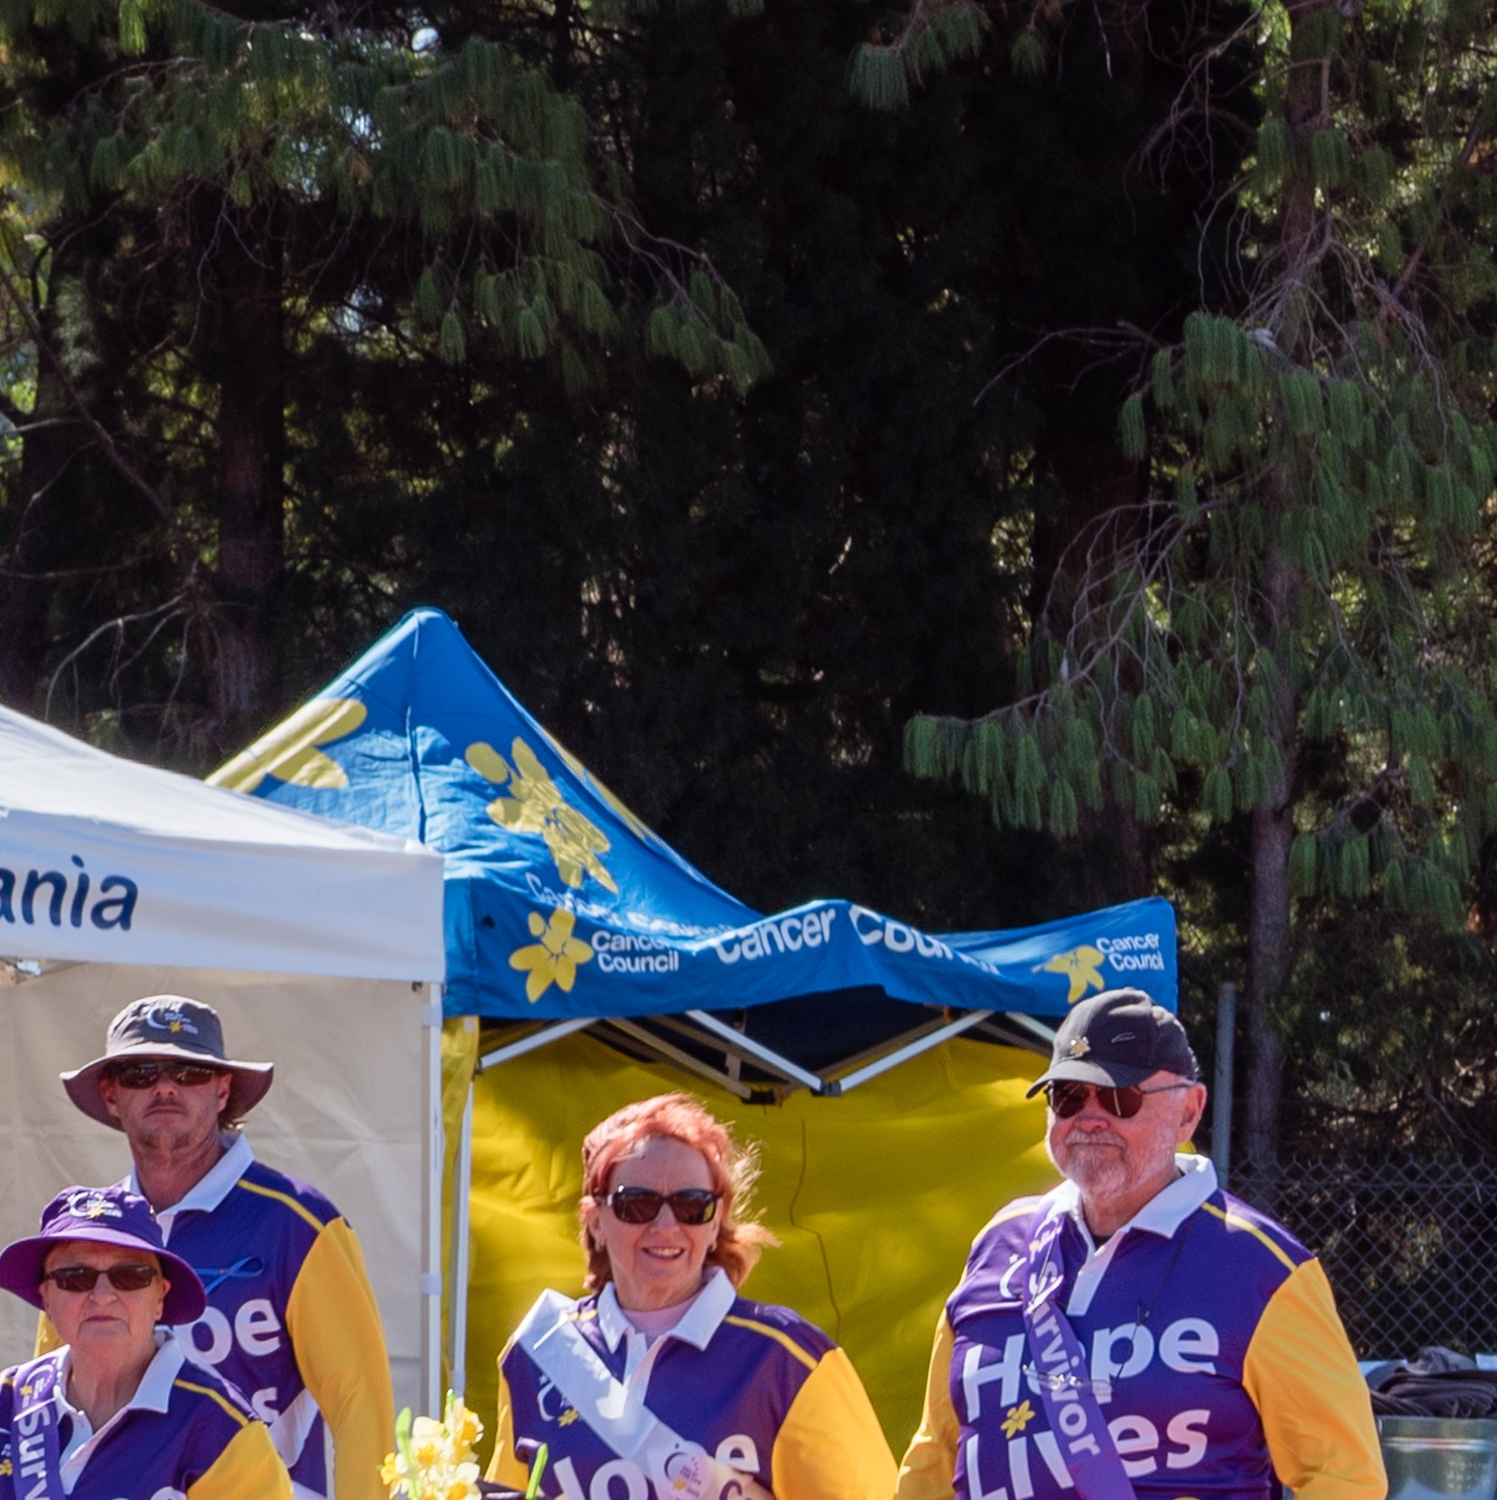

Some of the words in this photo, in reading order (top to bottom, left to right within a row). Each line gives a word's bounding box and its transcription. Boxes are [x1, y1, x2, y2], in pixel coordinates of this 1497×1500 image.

[591, 930, 672, 952] Canc
[714, 907, 837, 965] Cancer
[1096, 933, 1160, 955] Cancer
[598, 950, 679, 973] Council
[962, 1317, 1220, 1424] Hpe
